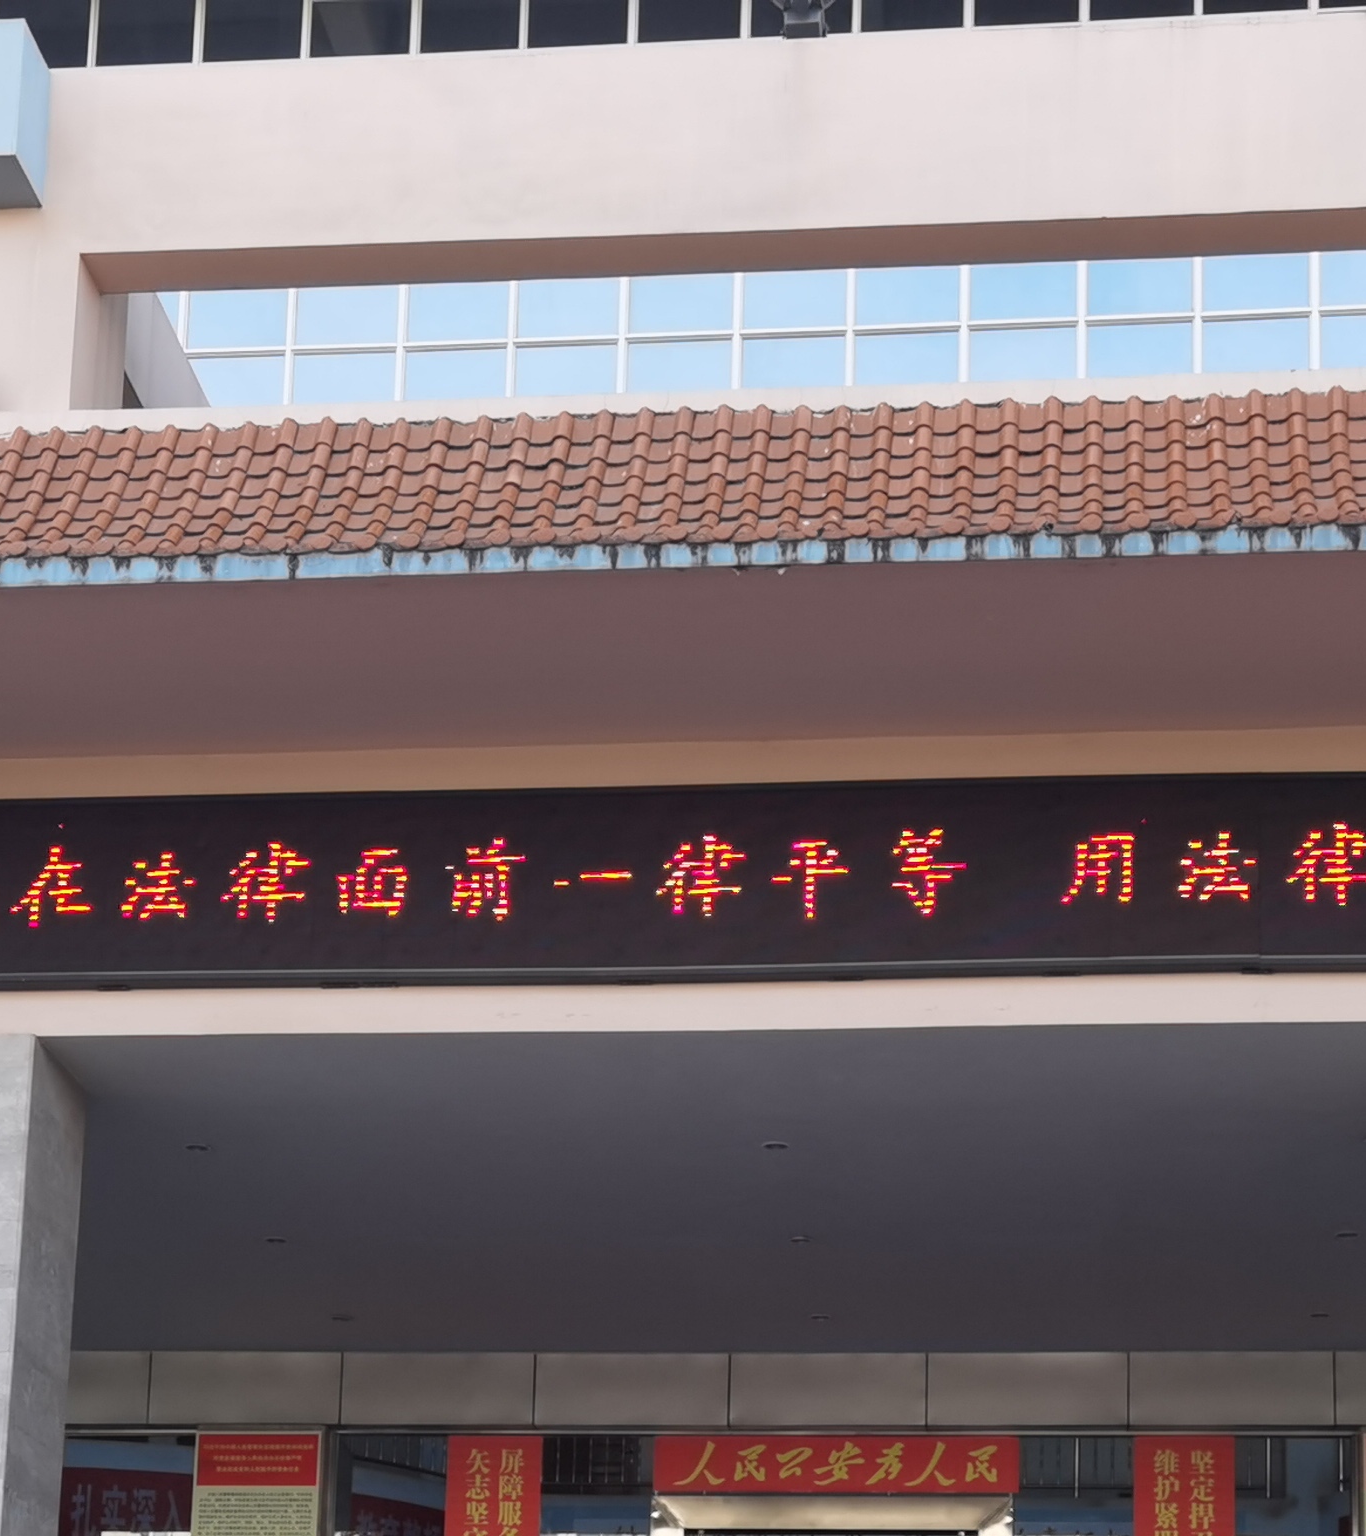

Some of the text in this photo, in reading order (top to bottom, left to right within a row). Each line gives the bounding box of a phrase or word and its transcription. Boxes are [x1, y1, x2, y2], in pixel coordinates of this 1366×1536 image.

[673, 1441, 999, 1487] 人民公安为人民
